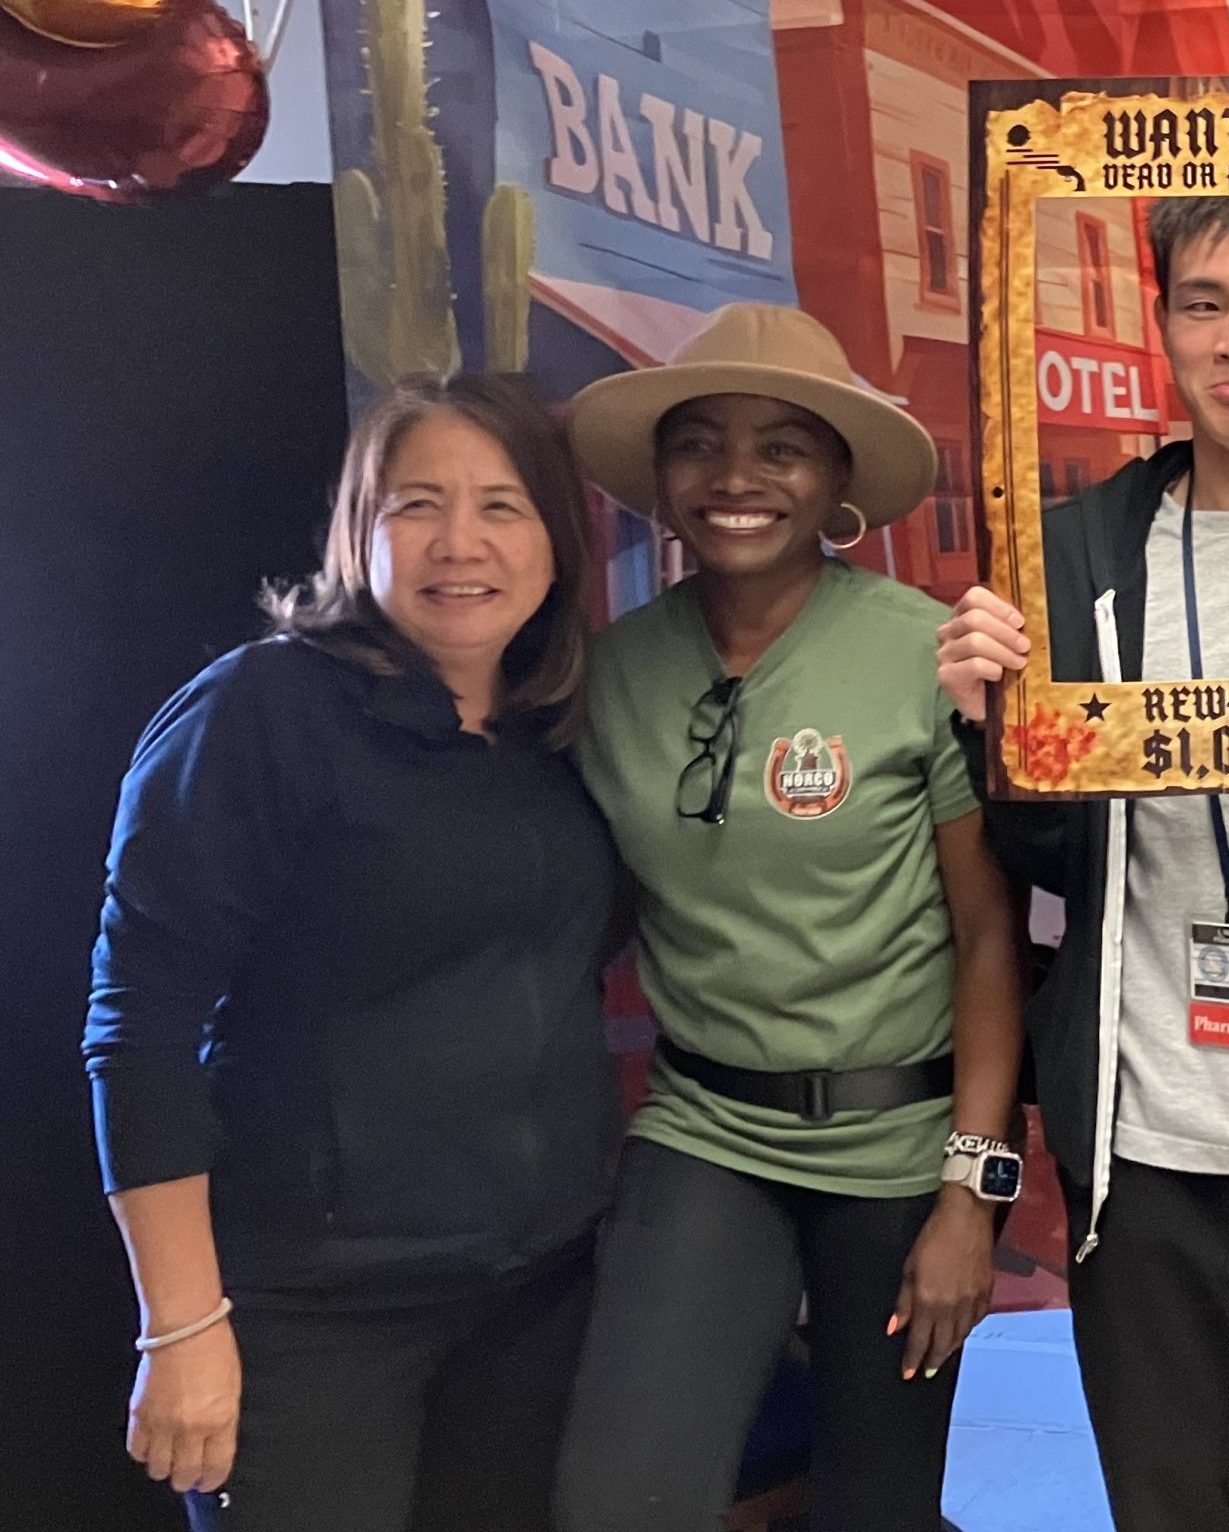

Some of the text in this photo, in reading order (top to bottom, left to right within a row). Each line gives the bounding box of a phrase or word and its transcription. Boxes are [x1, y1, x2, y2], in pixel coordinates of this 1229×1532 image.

[528, 40, 773, 260] BANK
[1103, 162, 1172, 190] DEAD
[1183, 161, 1218, 189] OR
[782, 771, 834, 787] NORCO
